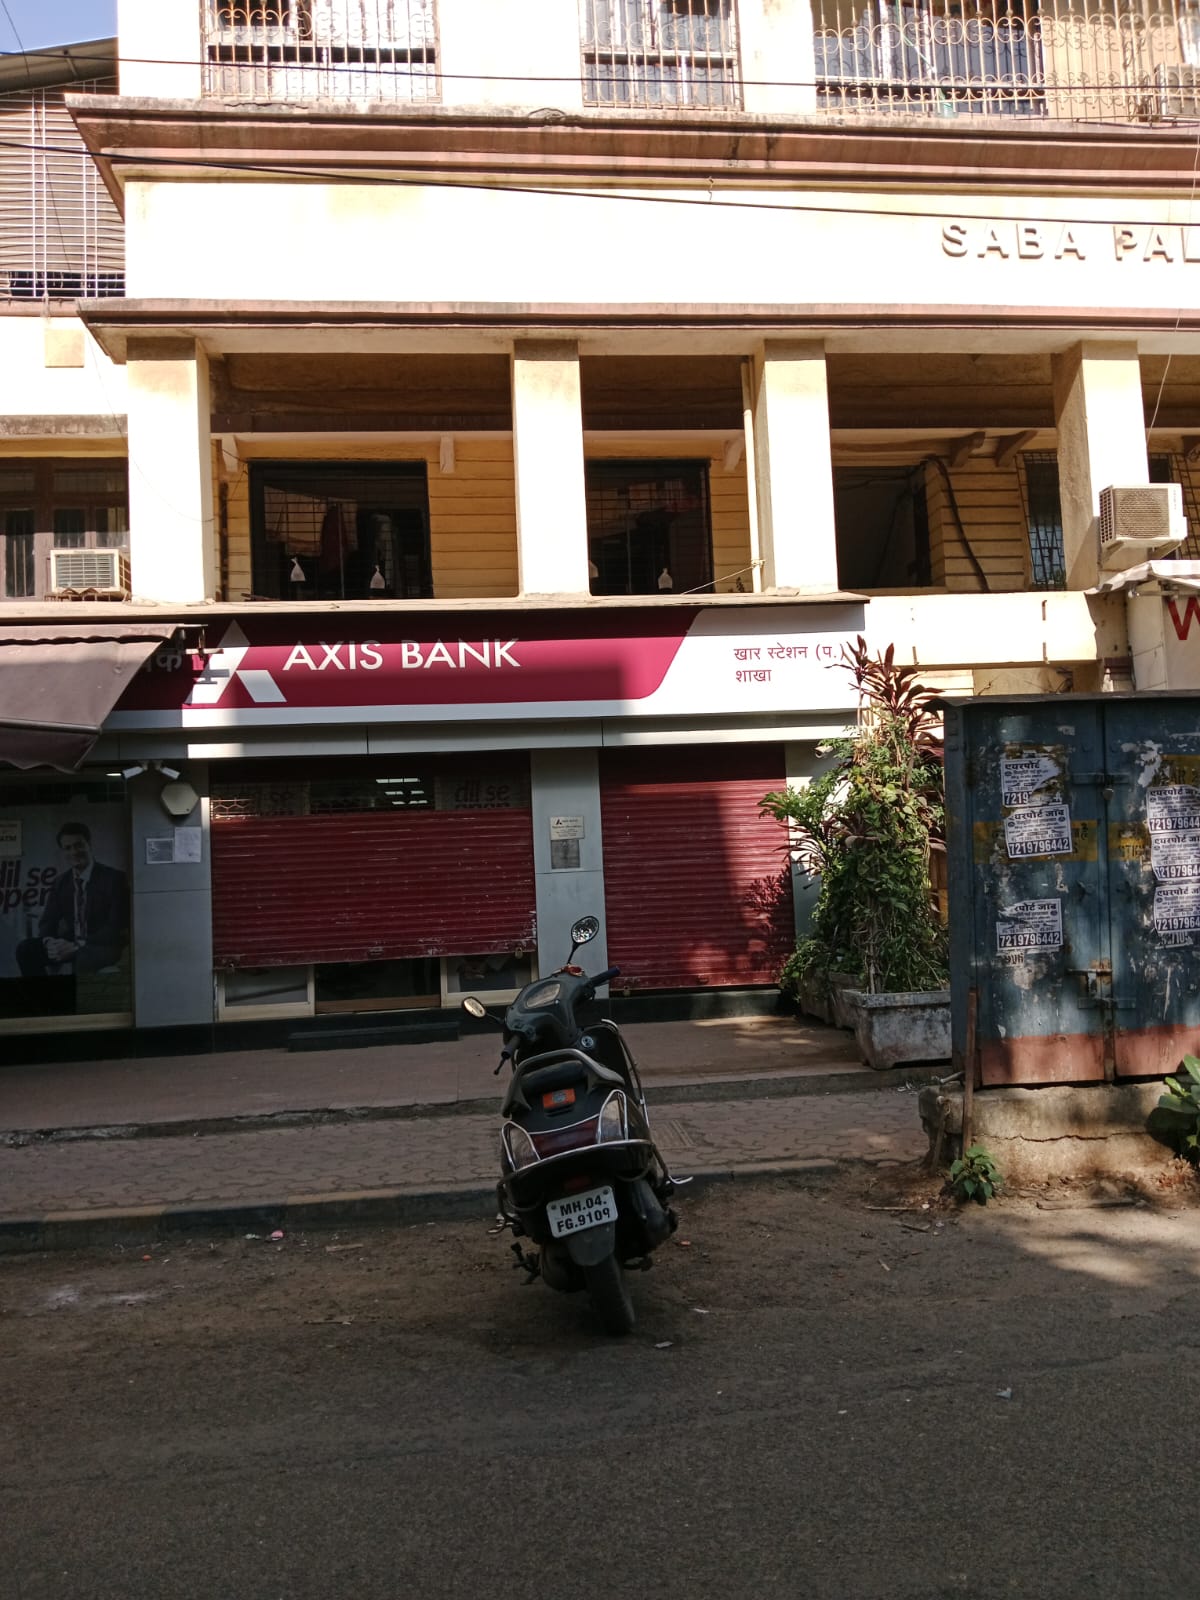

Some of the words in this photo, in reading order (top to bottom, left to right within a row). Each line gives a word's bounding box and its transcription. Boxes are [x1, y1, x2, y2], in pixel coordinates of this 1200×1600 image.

[941, 221, 1086, 261] SABA
[282, 640, 384, 671] AXIS
[400, 638, 521, 669] BANK
[733, 647, 761, 660] खार
[767, 642, 808, 659] स्टेशन
[735, 669, 772, 682] शाखा
[1149, 817, 1200, 831] 721979644
[1009, 838, 1069, 855] 7219796442
[26, 867, 58, 887] se
[1000, 932, 1060, 947] 7219796442
